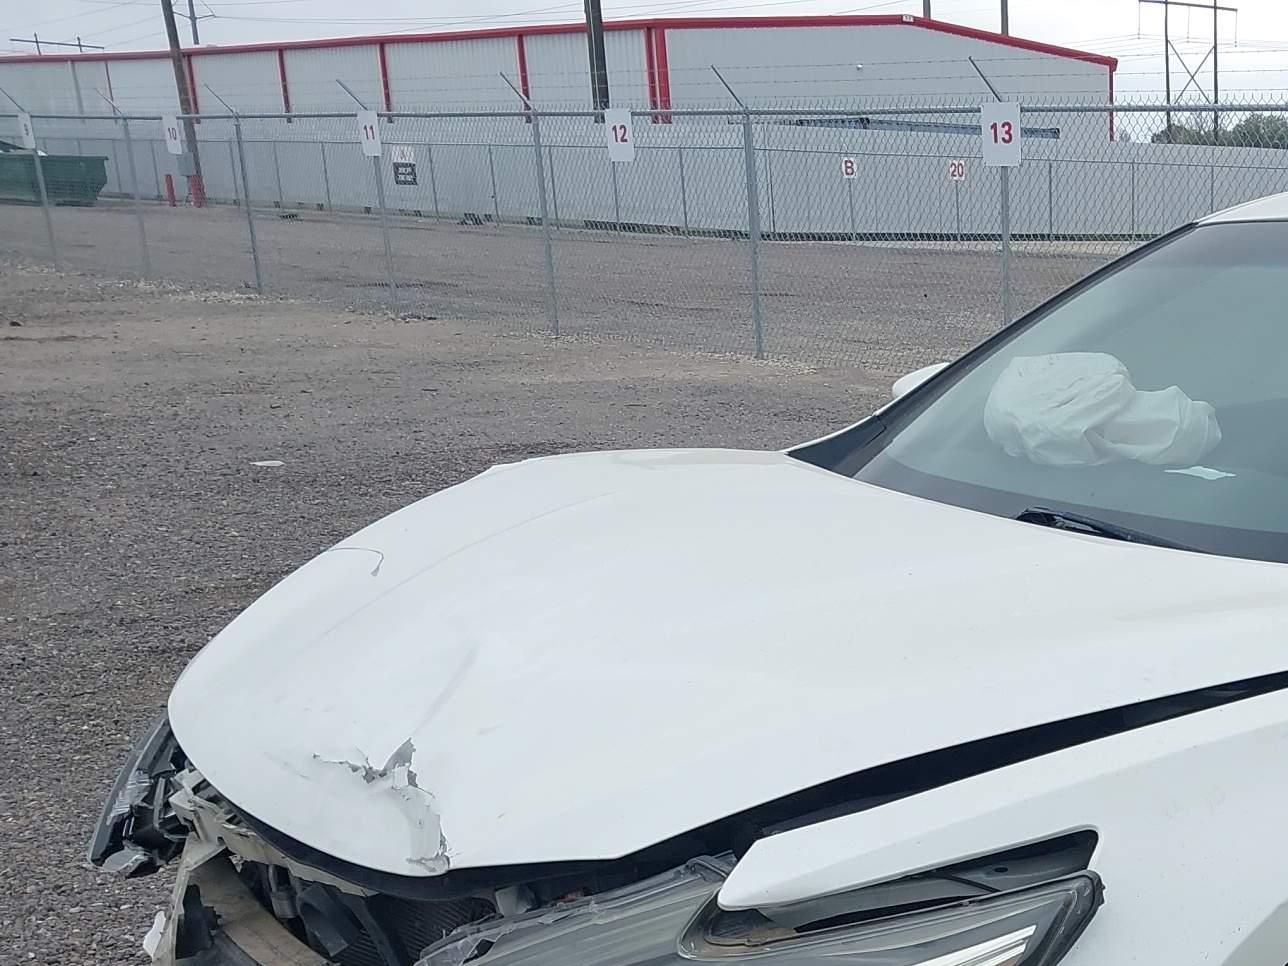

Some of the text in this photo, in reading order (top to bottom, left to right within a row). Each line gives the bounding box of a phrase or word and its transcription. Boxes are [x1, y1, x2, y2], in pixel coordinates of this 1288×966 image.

[167, 127, 177, 140] 10
[363, 125, 375, 140] 11
[612, 124, 628, 143] 12
[990, 121, 1013, 144] 13
[844, 159, 855, 176] B
[950, 162, 964, 177] 20
